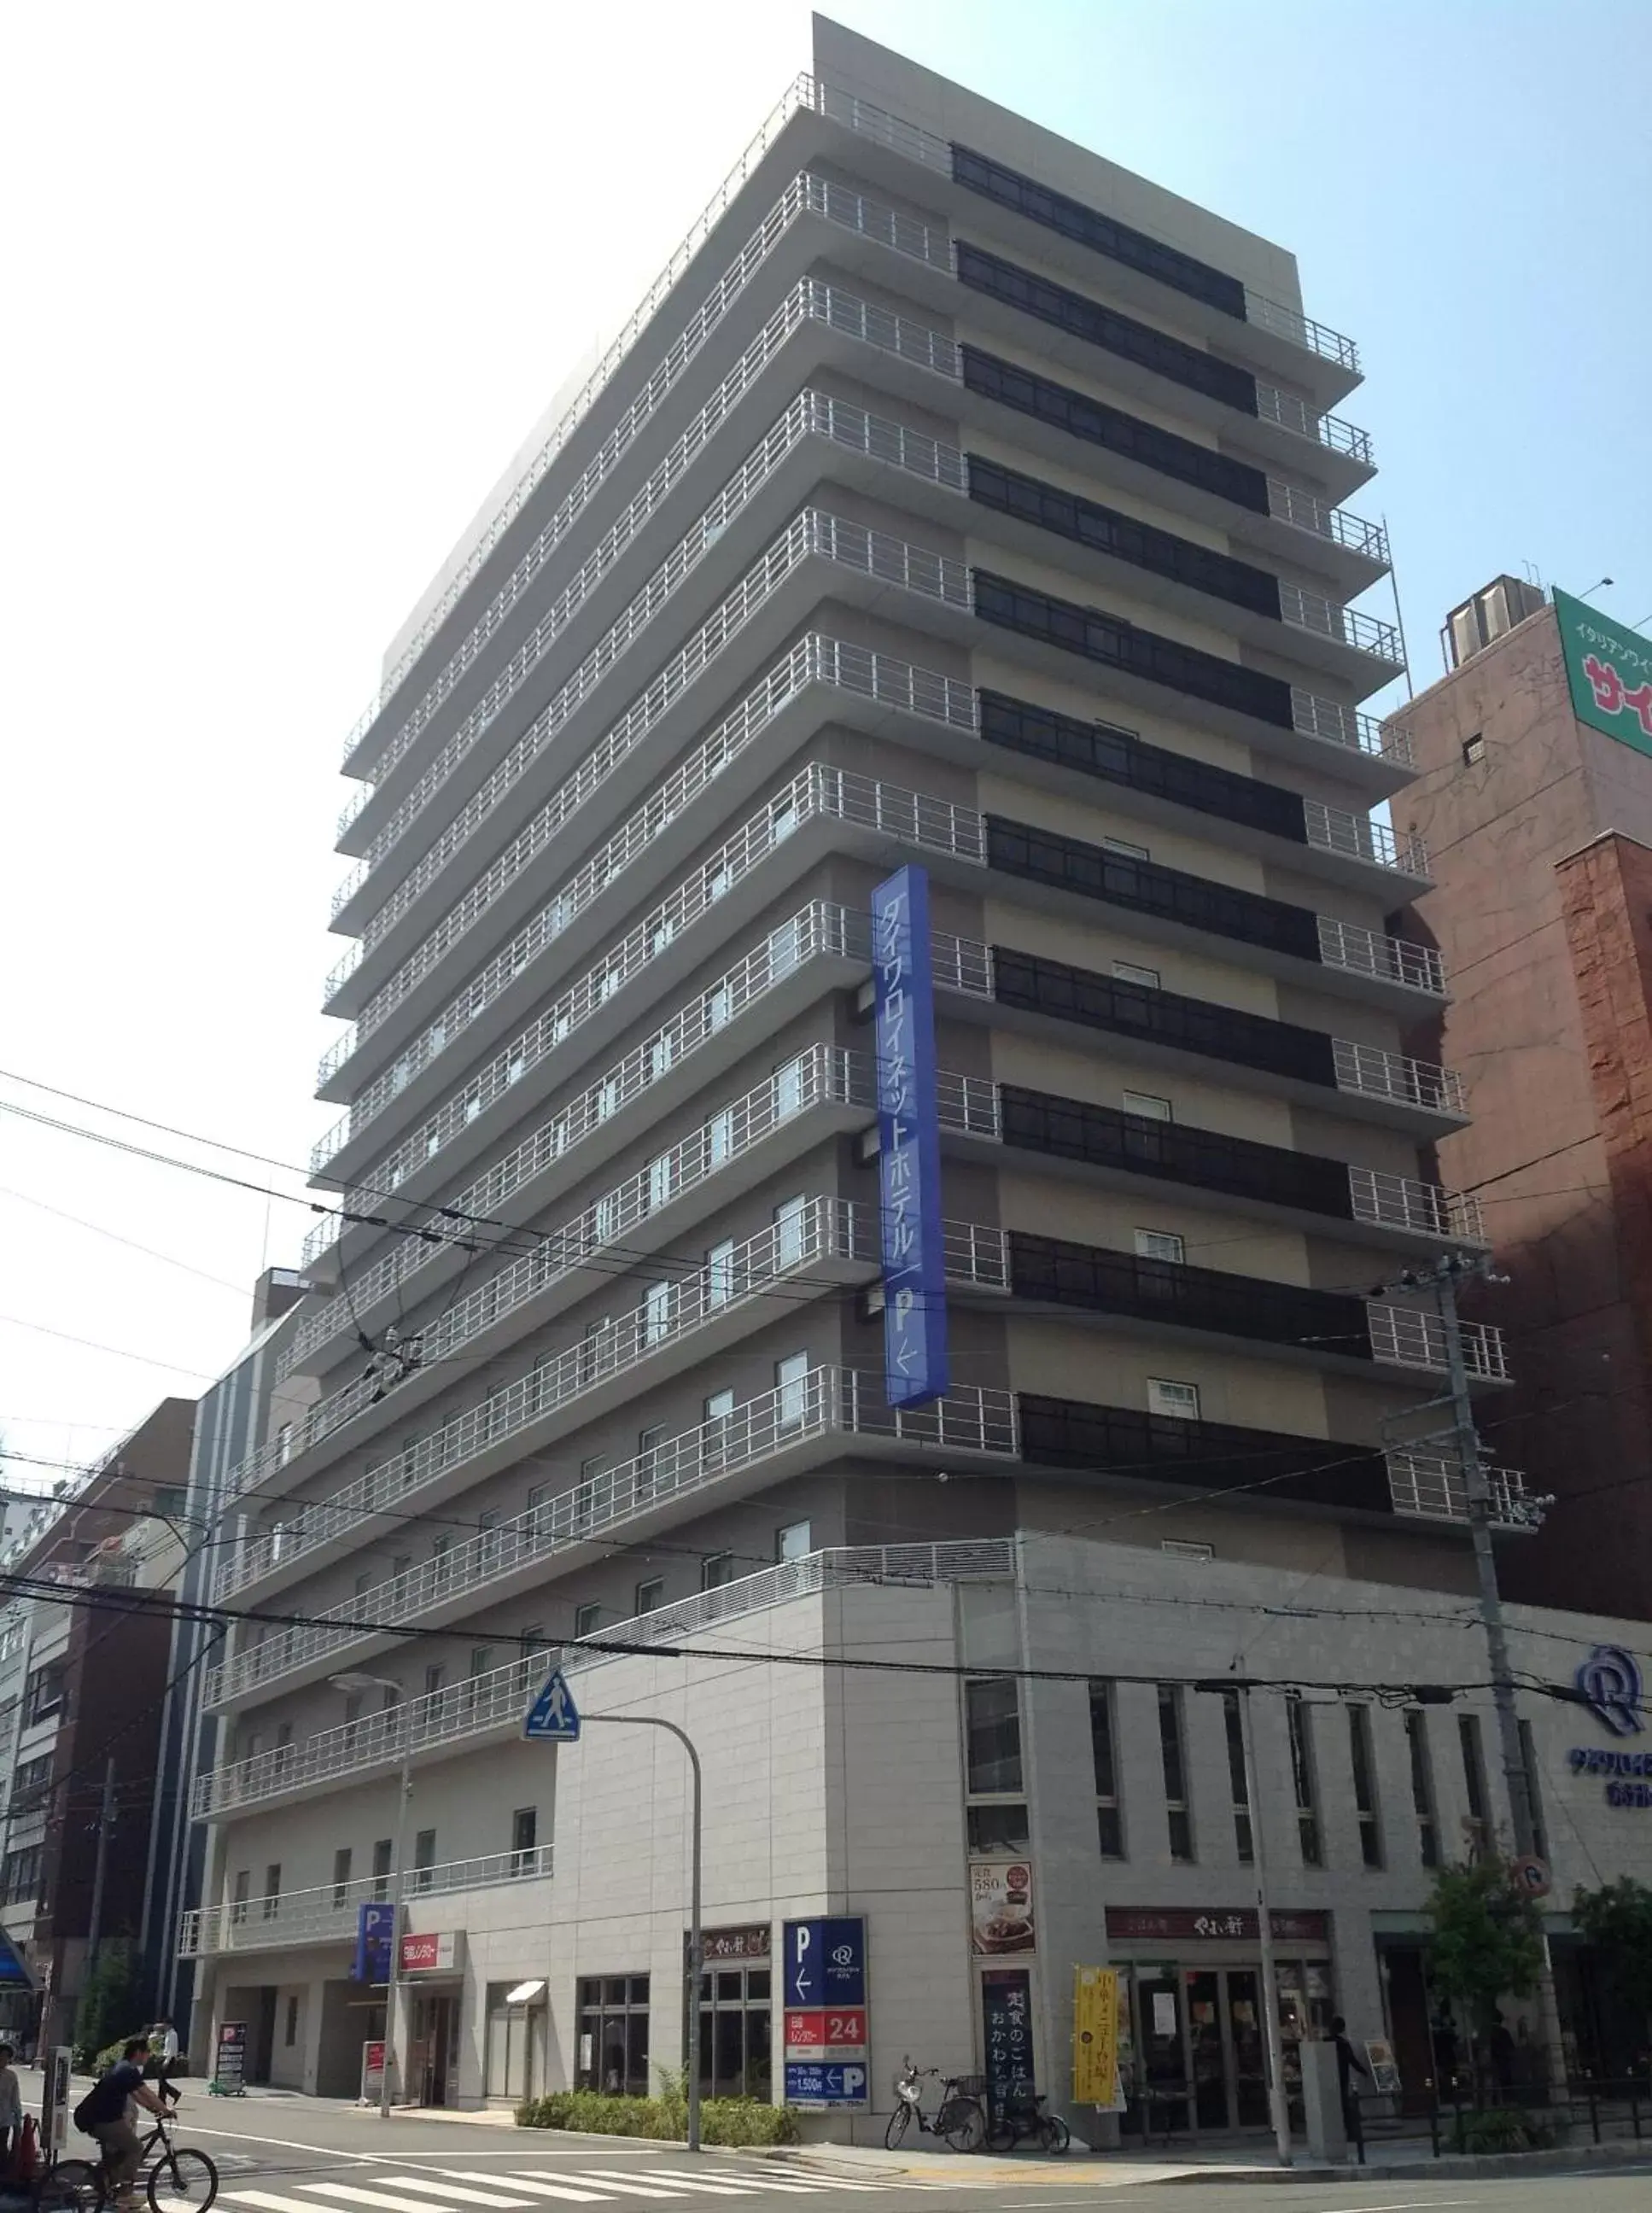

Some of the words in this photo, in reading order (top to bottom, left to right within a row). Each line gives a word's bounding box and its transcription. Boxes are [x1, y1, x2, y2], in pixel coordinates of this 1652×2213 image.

[879, 890, 915, 1261] ダイワロイネットホテル
[895, 1287, 913, 1334] P
[366, 1910, 381, 1932] P
[797, 1925, 811, 1964] P
[829, 2017, 861, 2041] 24
[842, 2066, 865, 2095] P
